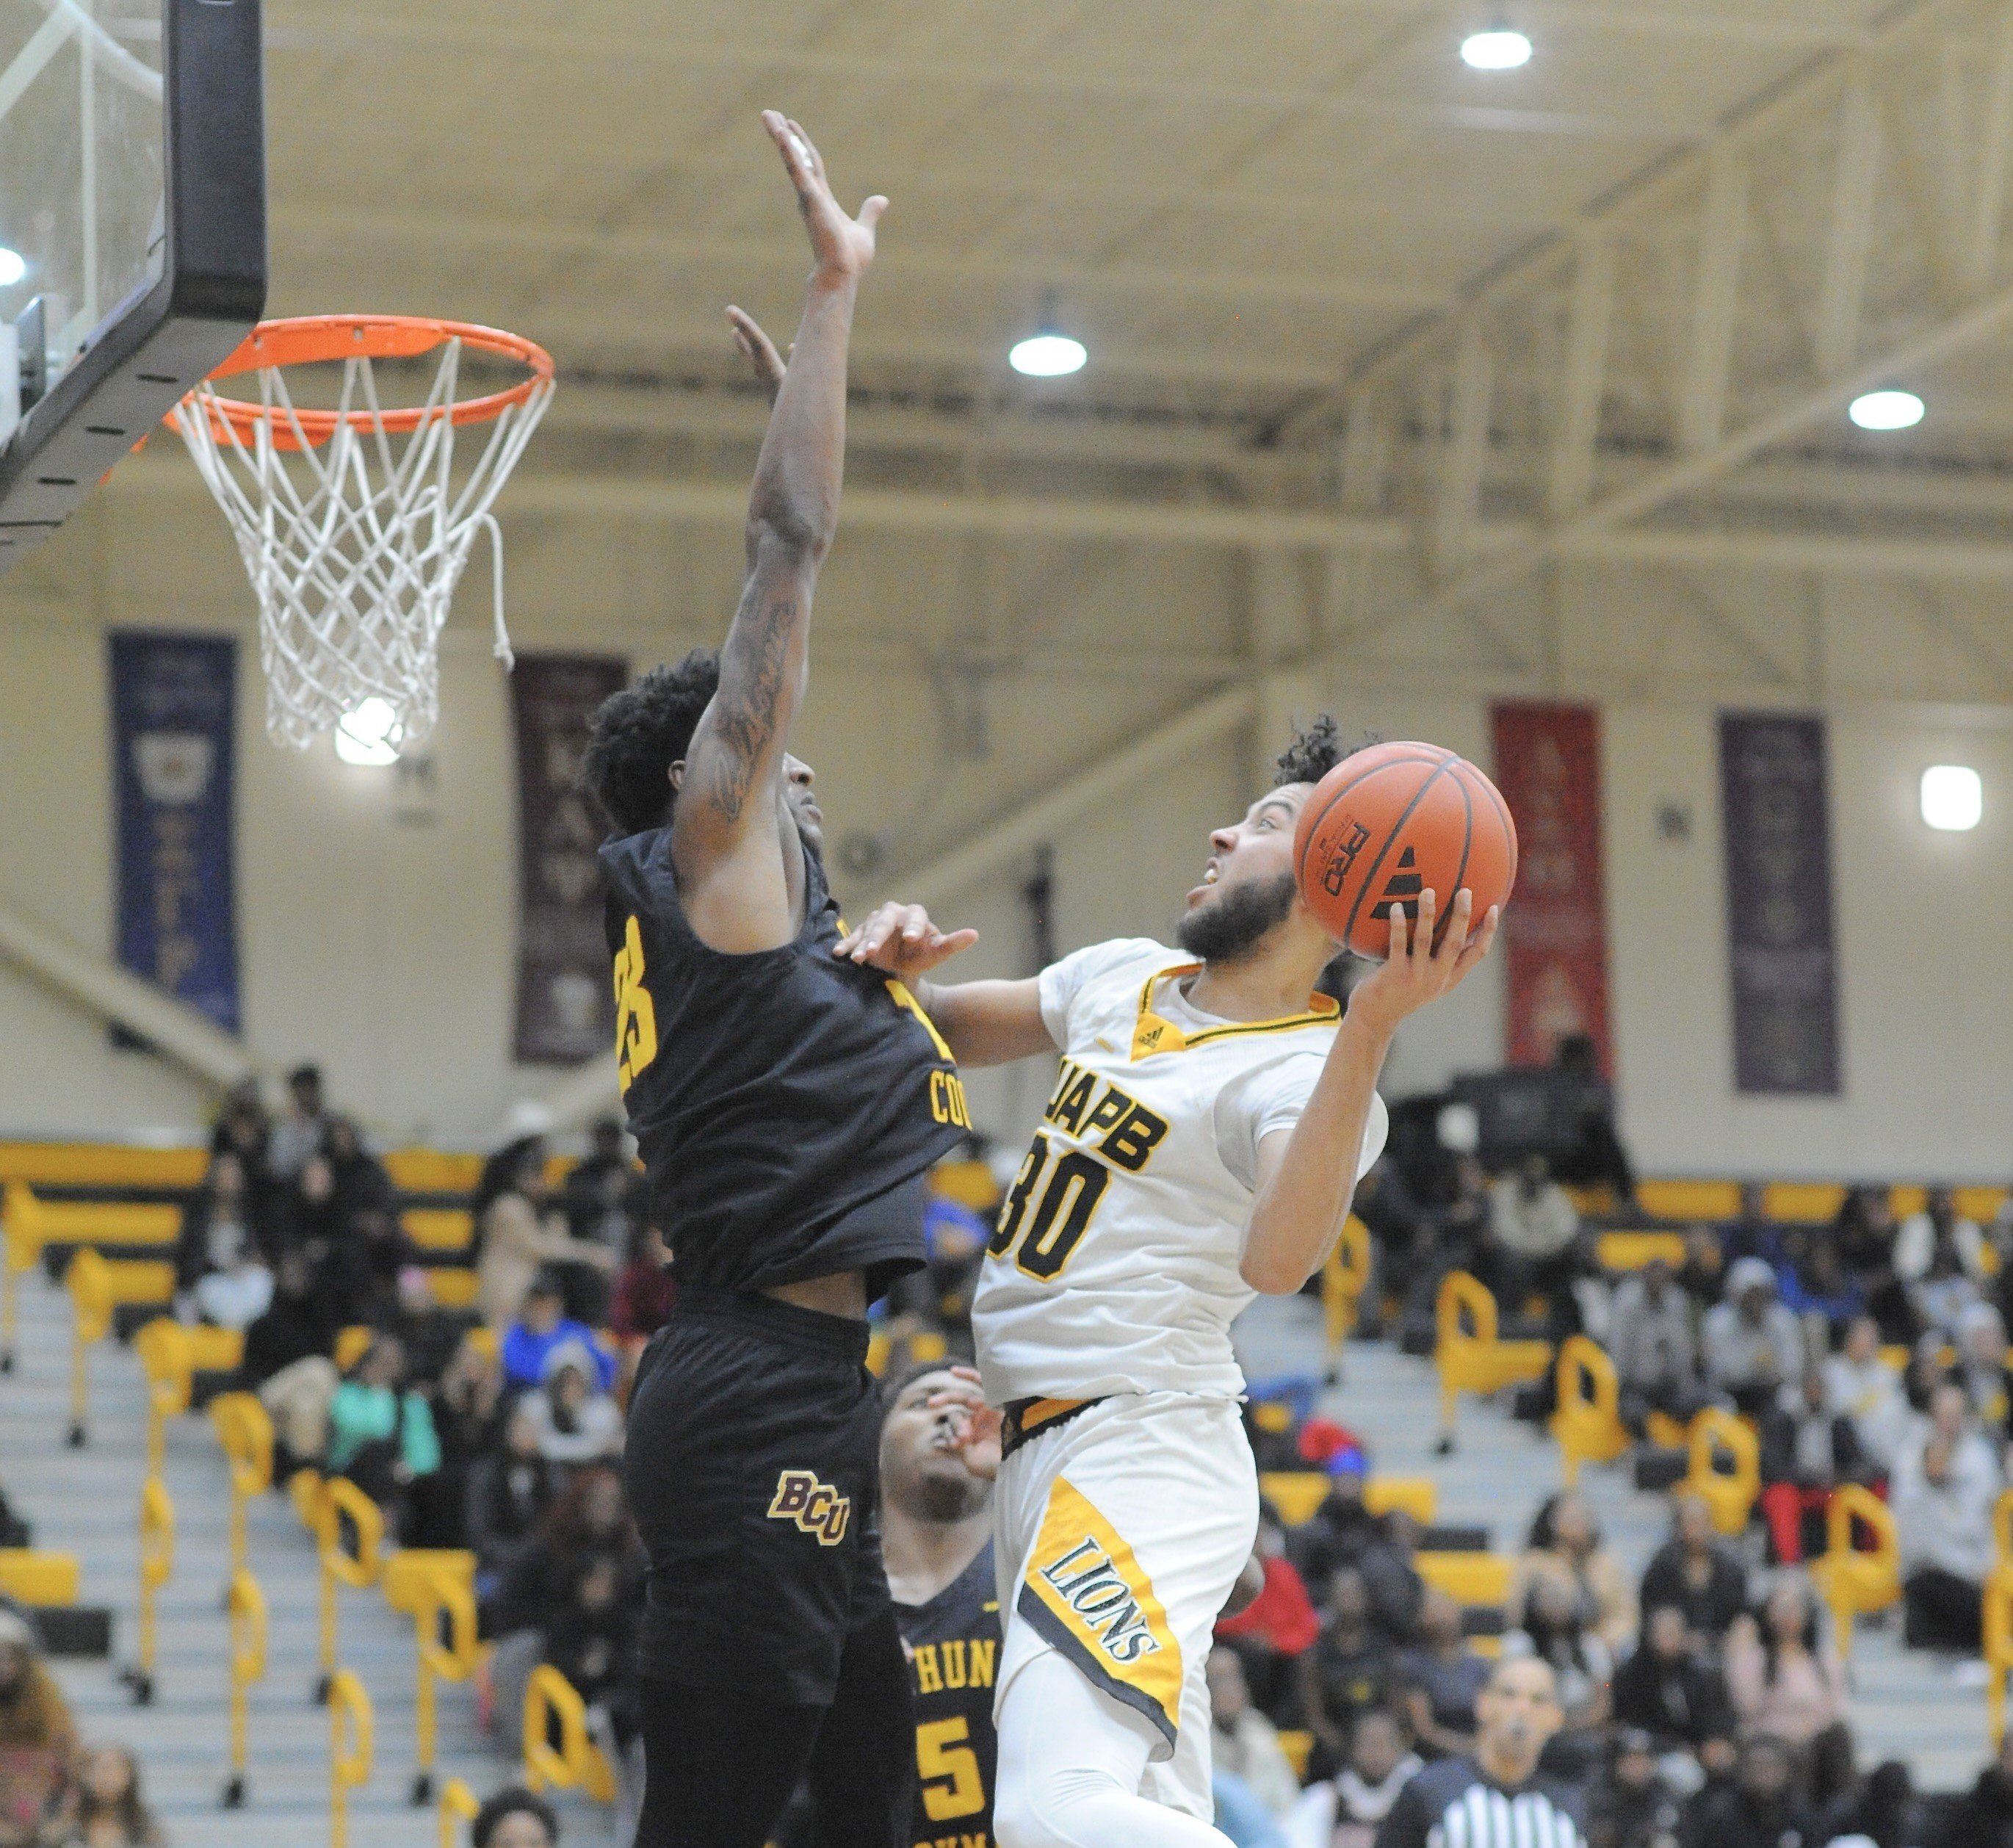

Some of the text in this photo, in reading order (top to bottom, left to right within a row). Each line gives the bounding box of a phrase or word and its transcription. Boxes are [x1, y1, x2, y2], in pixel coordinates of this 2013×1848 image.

[1324, 822, 1370, 897] PRO
[987, 1127, 1112, 1284] 30
[767, 1470, 850, 1546] BCU
[1038, 1534, 1163, 1665] LIONS
[916, 1716, 985, 1822] 5
